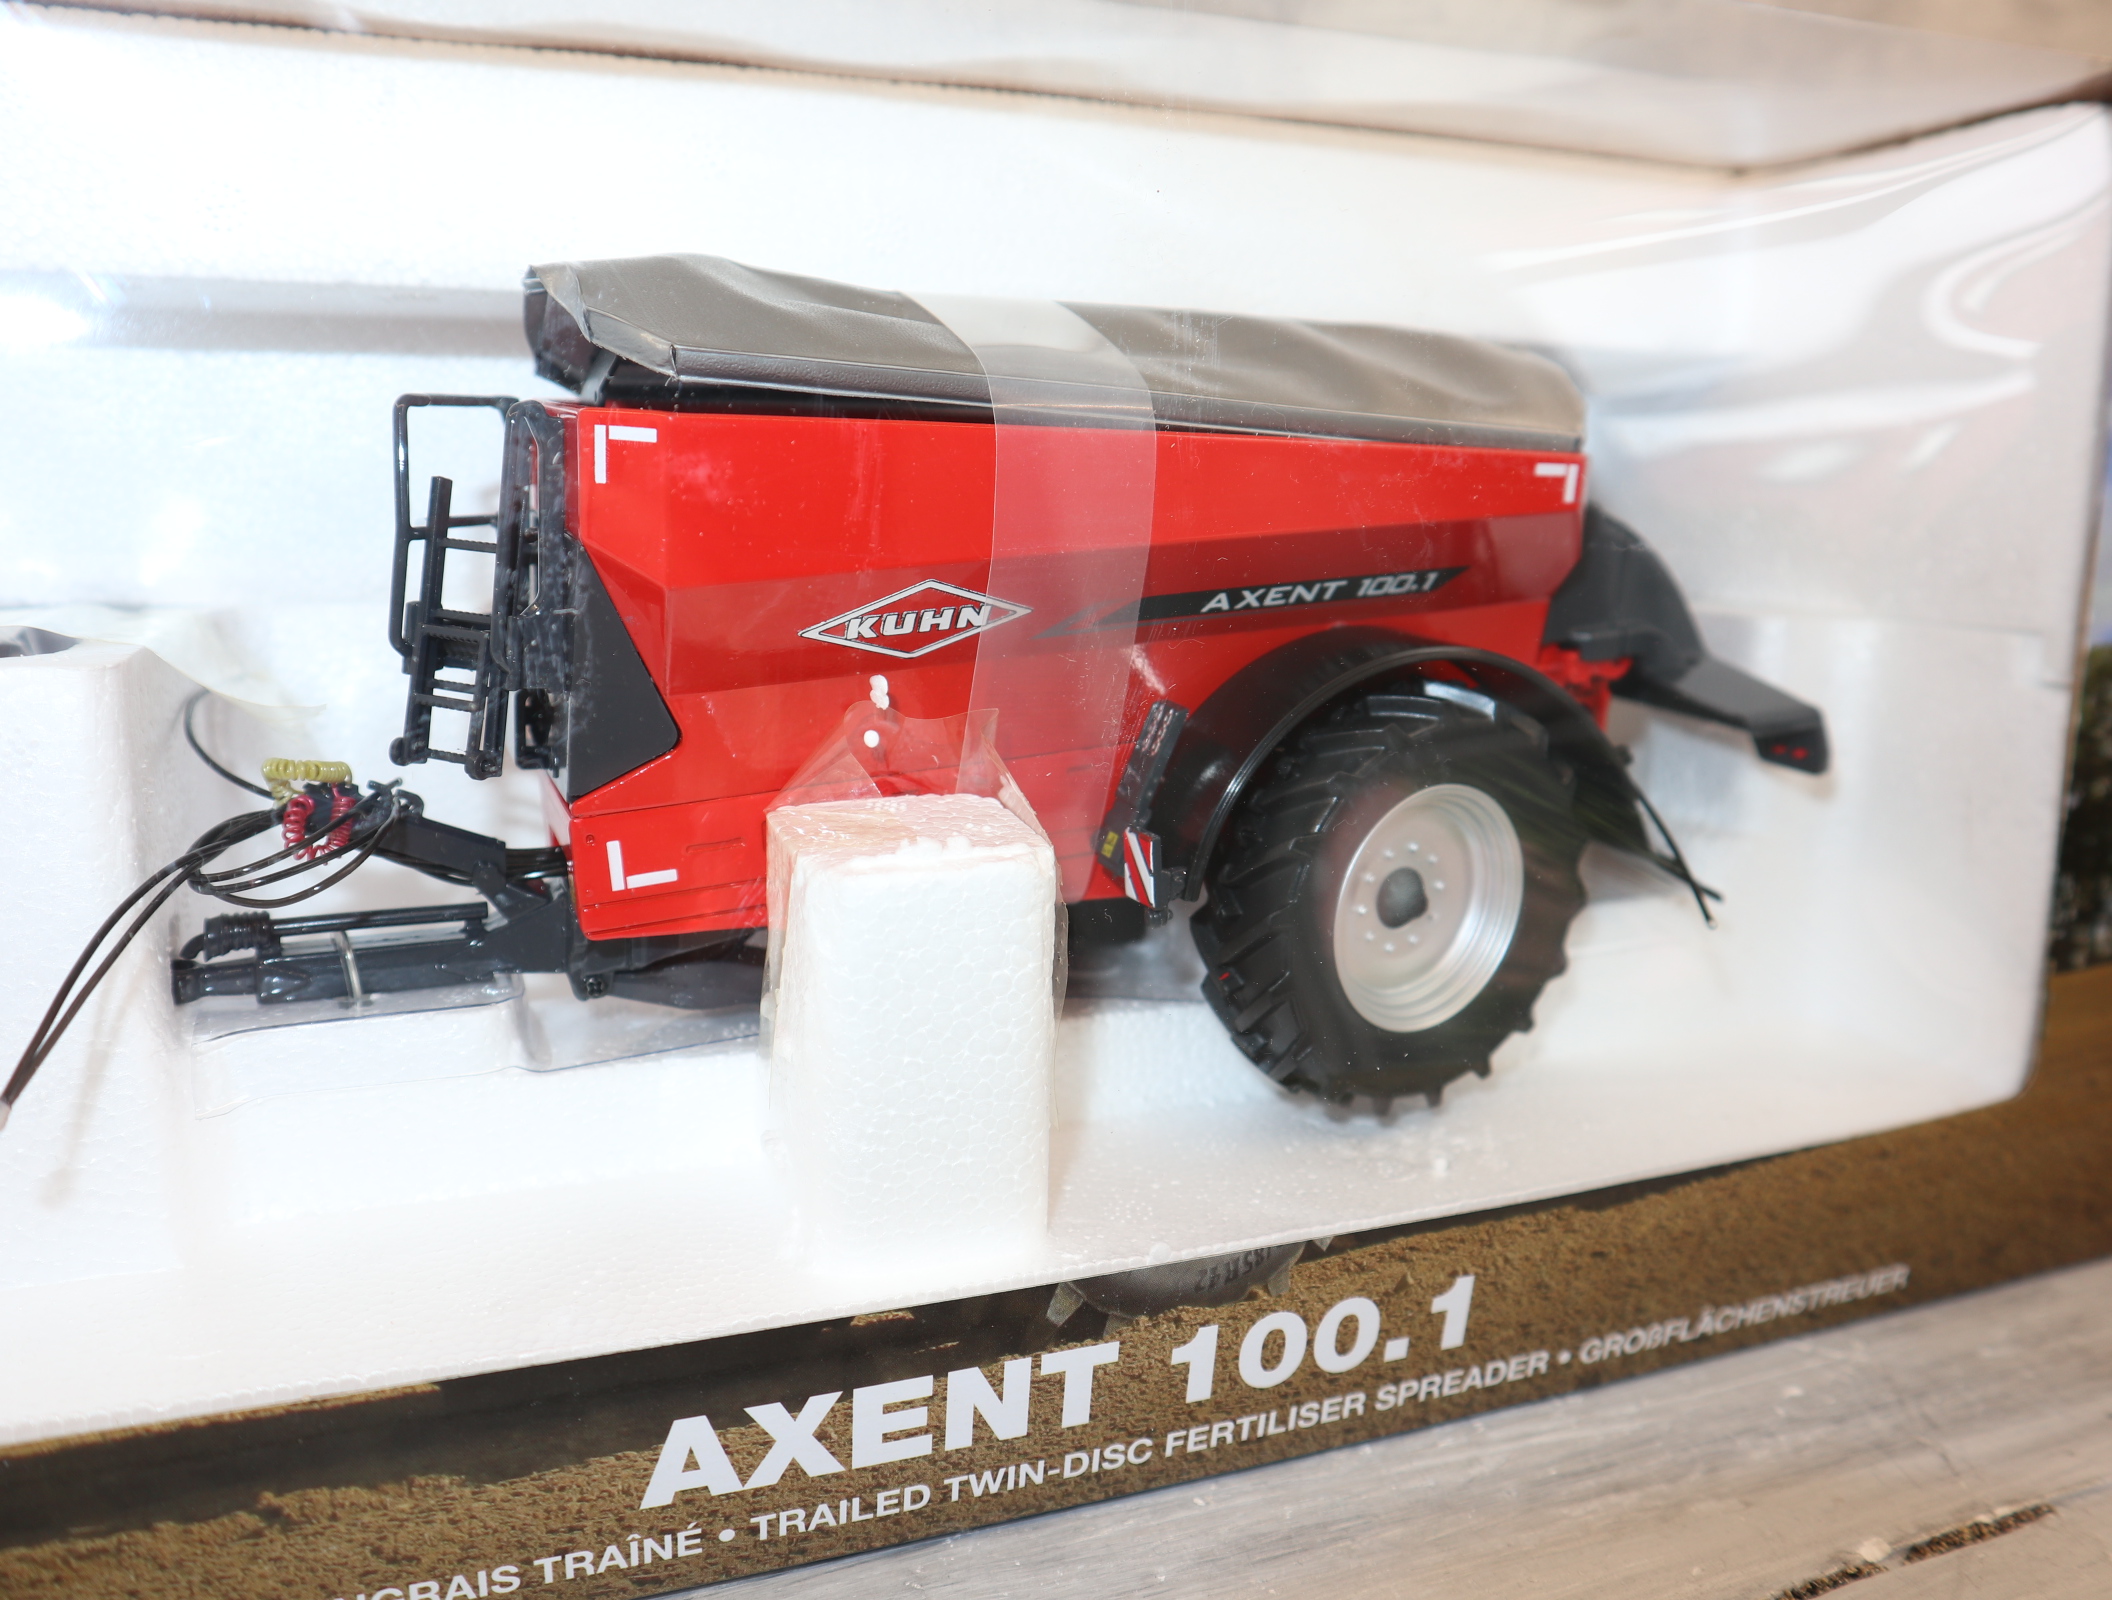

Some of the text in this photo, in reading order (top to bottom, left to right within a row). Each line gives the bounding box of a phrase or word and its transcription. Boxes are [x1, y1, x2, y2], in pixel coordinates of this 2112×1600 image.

[844, 603, 992, 640] KUHN
[1200, 571, 1429, 613] AXENT 100.1
[640, 1276, 1475, 1510] AXENT 100.1
[533, 1522, 703, 1584] TRAÎNÉ
[750, 1484, 931, 1541] TRAILED
[943, 1438, 1153, 1502] TWIN-DISC
[1165, 1392, 1366, 1457] FERTILISER
[1374, 1351, 1550, 1411] SPREADER
